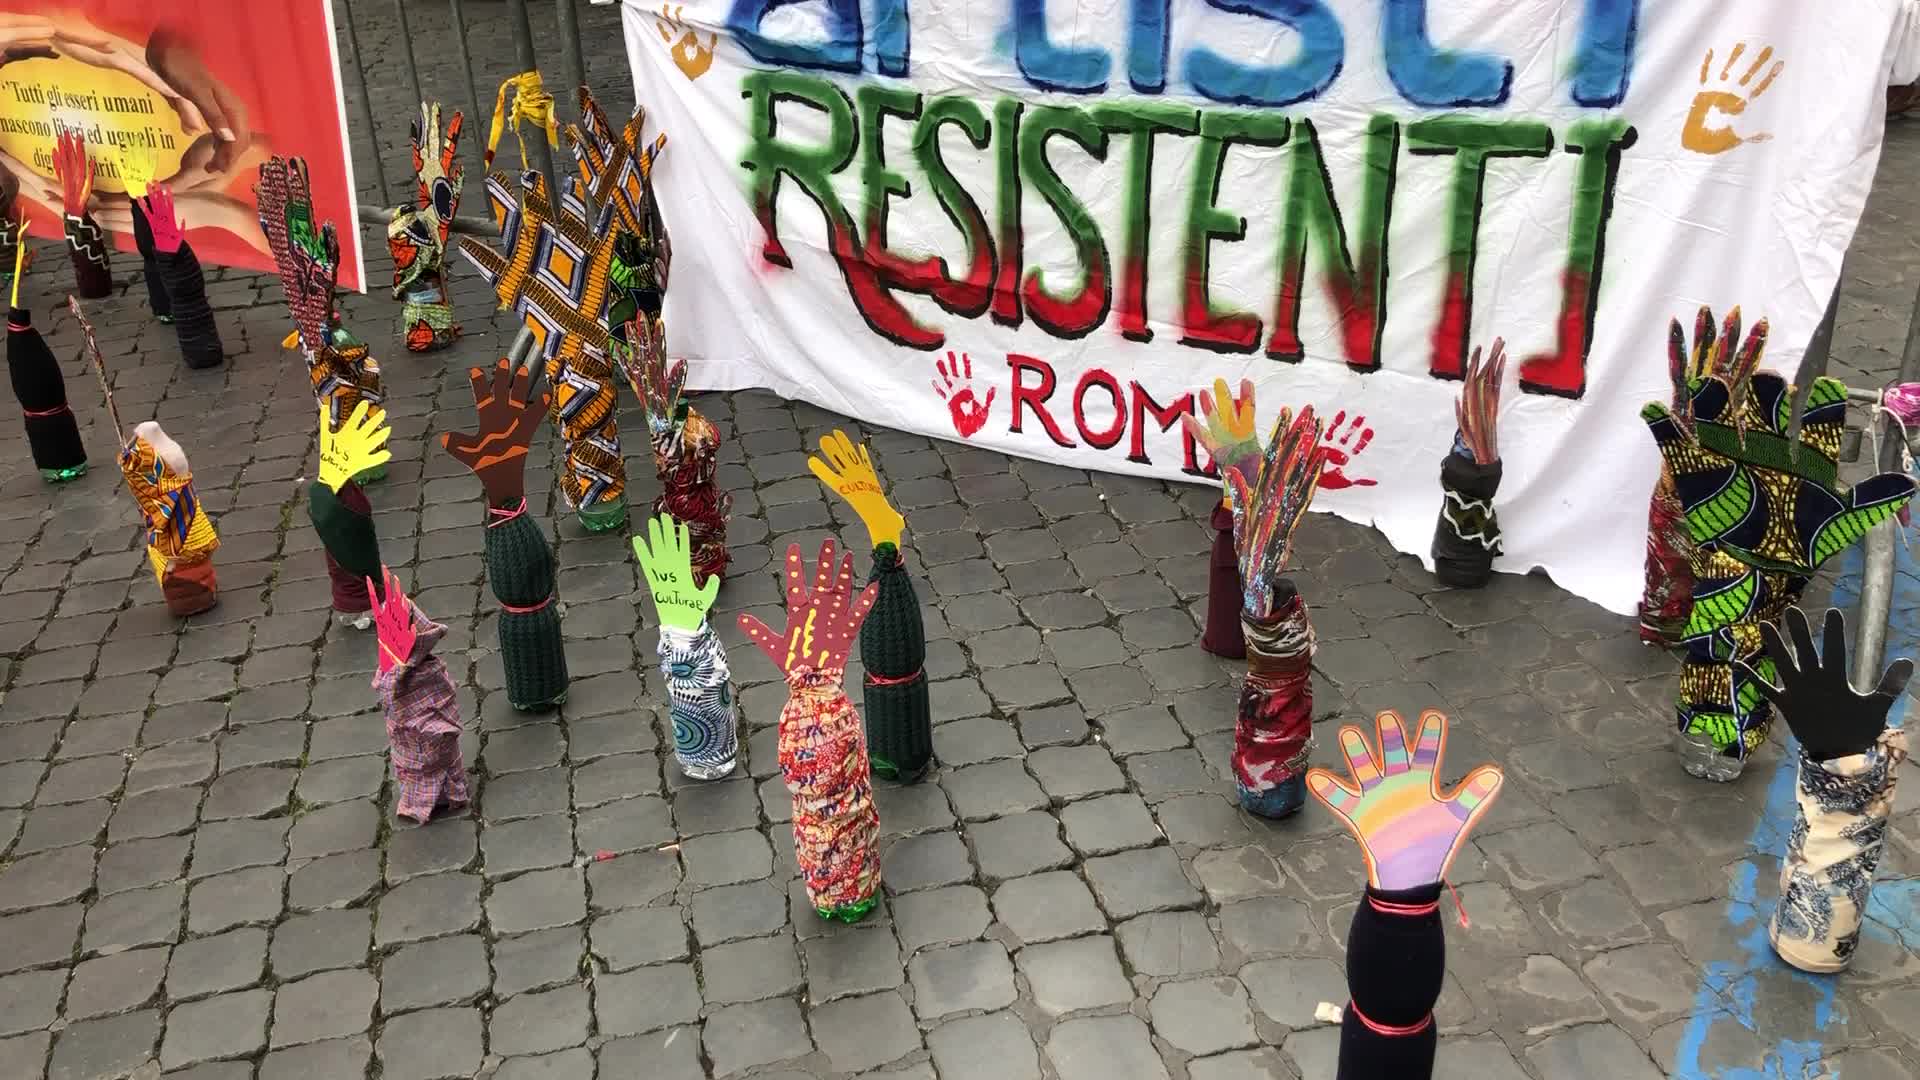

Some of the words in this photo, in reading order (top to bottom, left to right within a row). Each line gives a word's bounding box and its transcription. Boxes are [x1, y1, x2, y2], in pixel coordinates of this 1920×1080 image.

[47, 84, 63, 111] gli
[64, 89, 100, 112] esseri
[102, 92, 155, 115] umani
[88, 123, 104, 145] ed
[160, 128, 176, 150] in
[740, 70, 1638, 399] RESISTENTI
[1006, 352, 1246, 481] ROM
